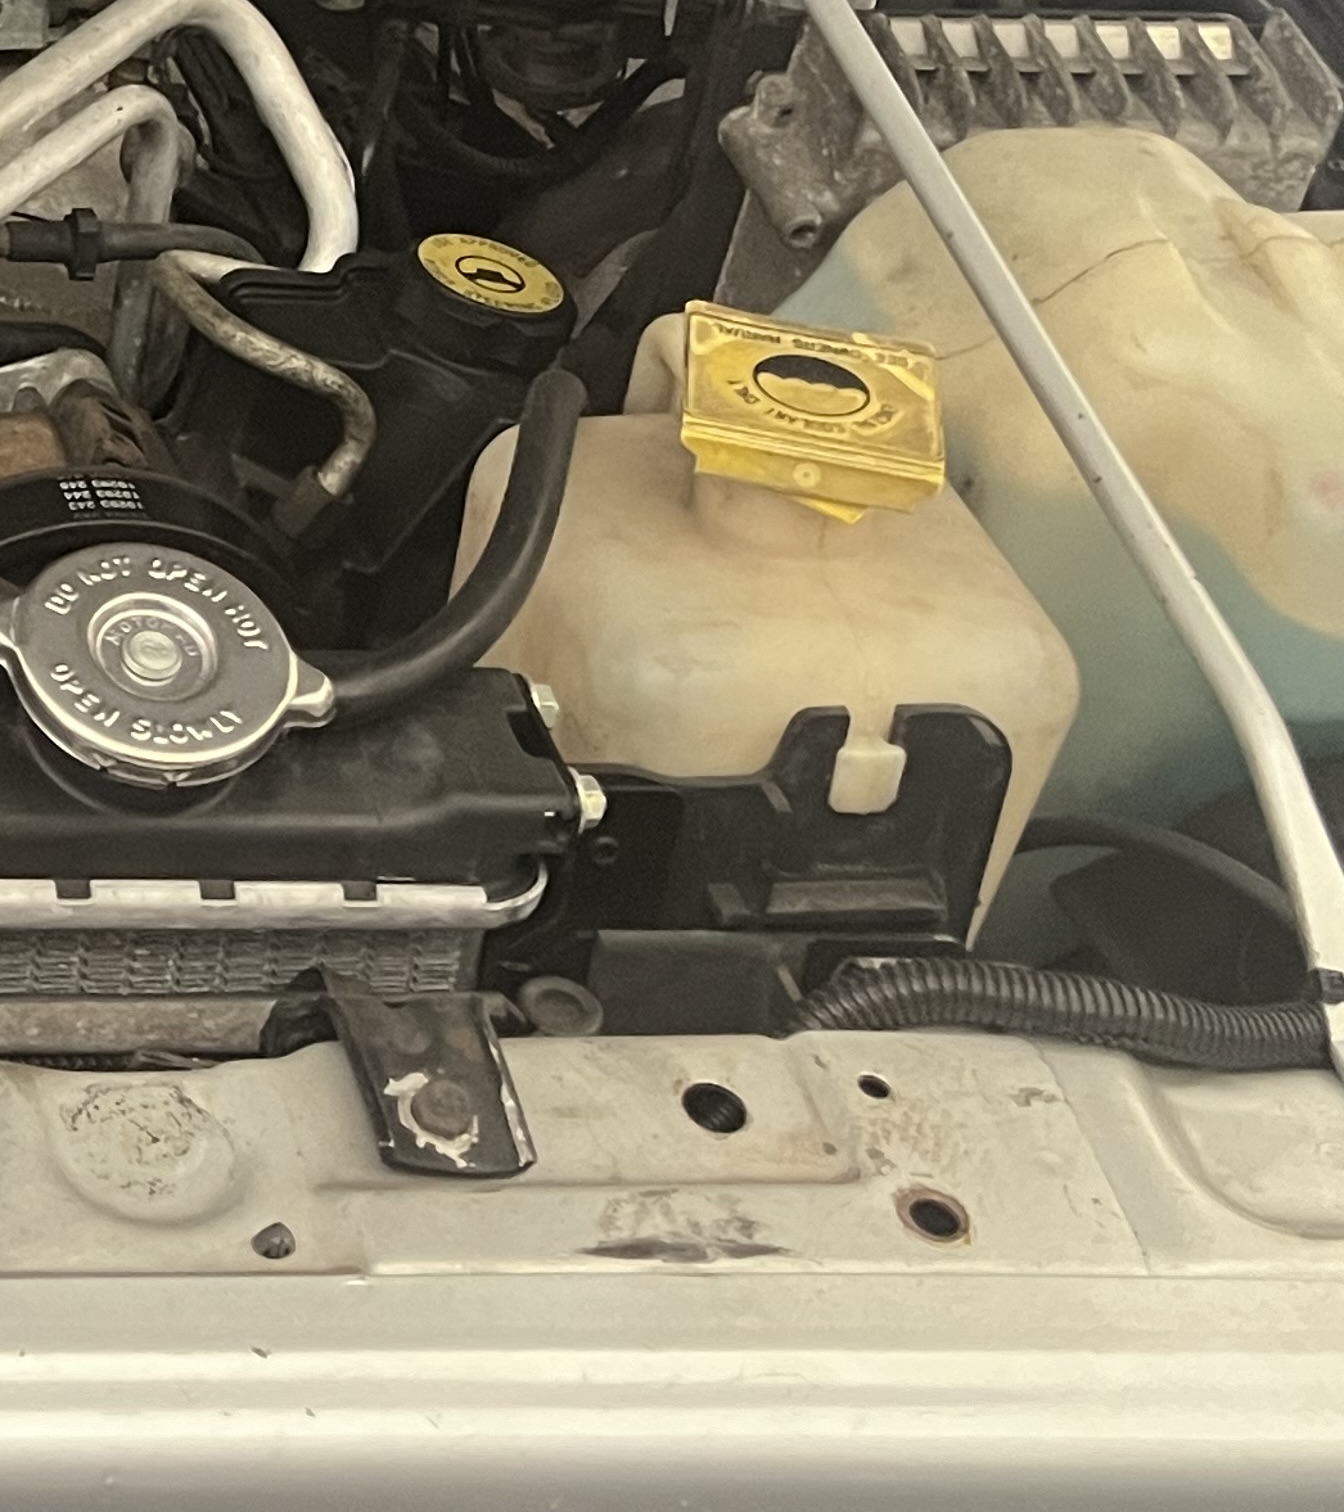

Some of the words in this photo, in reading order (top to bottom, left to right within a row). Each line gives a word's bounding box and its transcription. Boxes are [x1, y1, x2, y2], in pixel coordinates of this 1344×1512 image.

[45, 584, 80, 617] DO
[77, 555, 132, 588] NOT
[148, 557, 229, 604] OPEN
[224, 603, 270, 652] HOT
[49, 662, 121, 728] OPEN
[129, 708, 246, 745] SLOWLY
